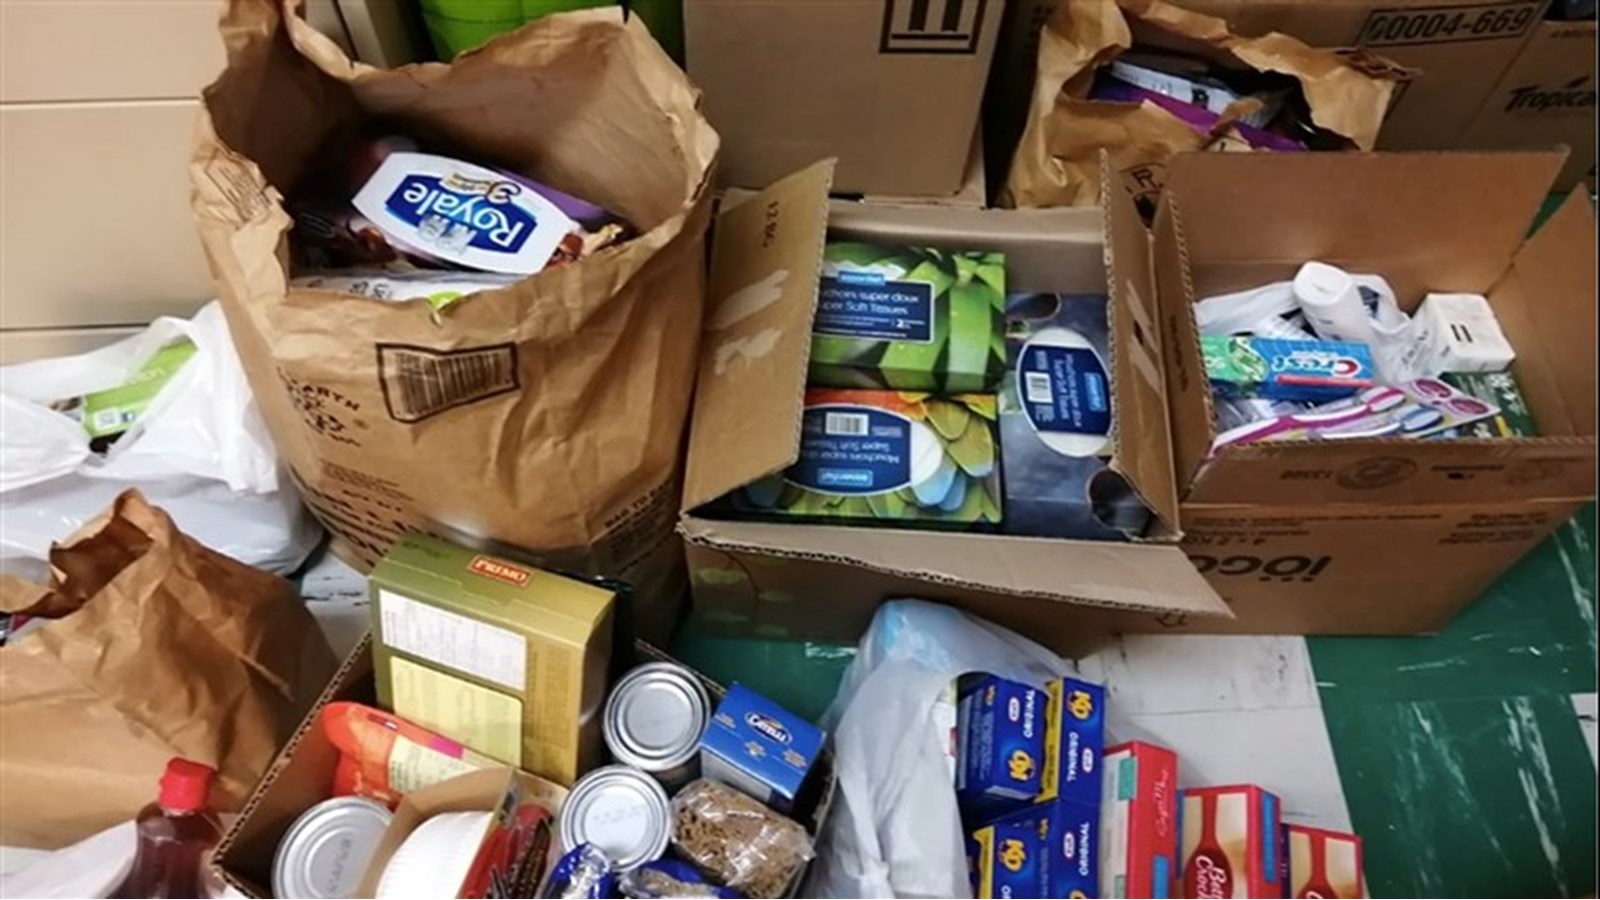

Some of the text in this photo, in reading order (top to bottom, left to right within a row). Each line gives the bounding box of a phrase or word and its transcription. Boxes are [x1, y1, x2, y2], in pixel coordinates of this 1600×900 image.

[403, 182, 524, 247] Royale
[846, 301, 868, 312] Soft
[1271, 356, 1362, 378] Crest
[475, 559, 527, 582] PRIMO
[1024, 689, 1036, 738] ORIGINAL
[1070, 690, 1093, 719] KD
[1008, 750, 1033, 781] KD
[1066, 731, 1079, 782] ORIGINAL
[1003, 839, 1027, 872] KD
[1078, 821, 1090, 876] ORIGINAL
